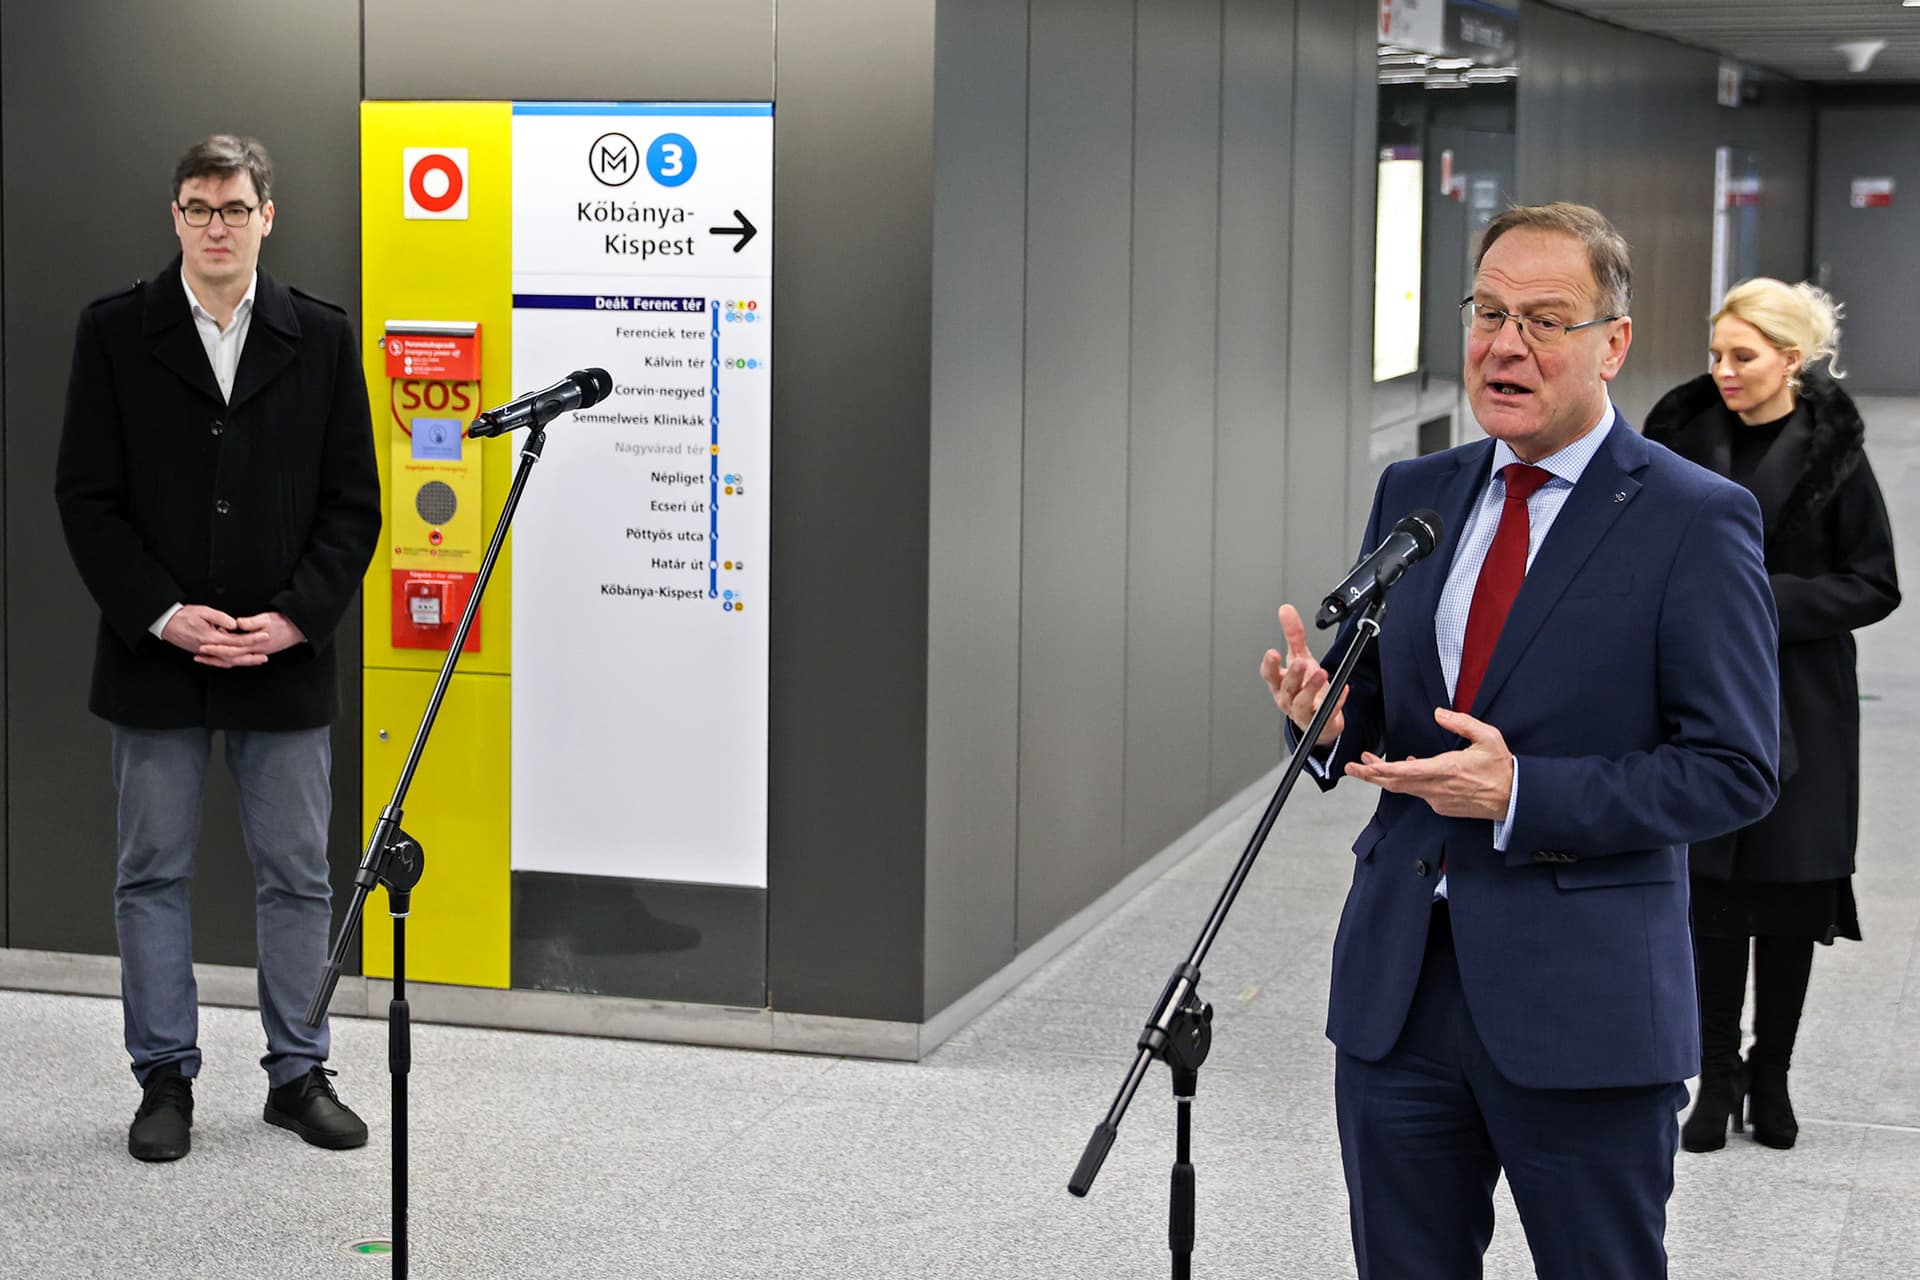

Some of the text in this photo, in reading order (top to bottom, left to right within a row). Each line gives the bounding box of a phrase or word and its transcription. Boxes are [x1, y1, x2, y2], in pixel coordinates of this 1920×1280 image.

[661, 144, 683, 176] 3
[578, 201, 694, 229] Kőbánya-
[606, 234, 694, 260] Kispest
[596, 298, 702, 311] Deák Ferenc tér
[616, 327, 706, 339] Ferenciek tere
[644, 356, 705, 369] Kálvin tér
[402, 381, 471, 411] SOS
[614, 384, 705, 400] Corvin-negyed
[572, 412, 705, 426] Semmelweis Klinikák
[614, 441, 705, 457] Nagyvárad tér
[650, 471, 704, 487] Népliget
[650, 500, 704, 513] Ecseri út
[626, 527, 704, 543] Pöttyös utca
[651, 557, 704, 571] Határ út
[600, 584, 703, 601] Kőbánya-Kispest
